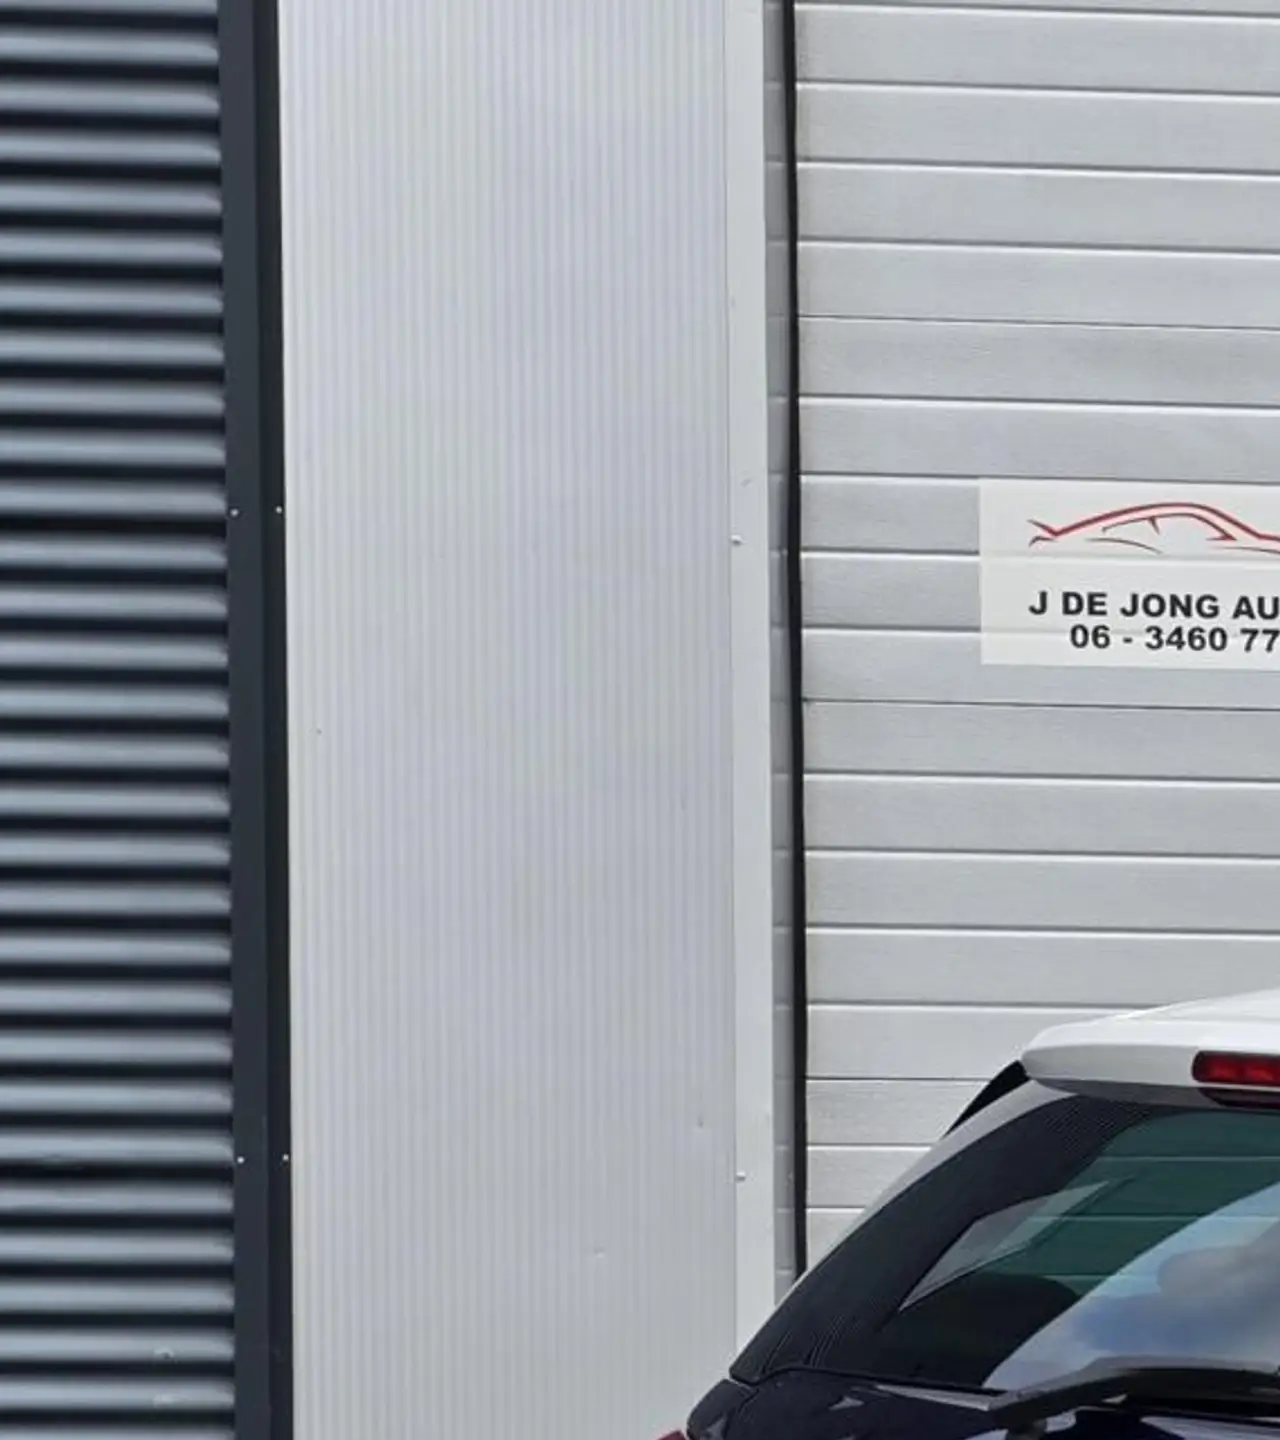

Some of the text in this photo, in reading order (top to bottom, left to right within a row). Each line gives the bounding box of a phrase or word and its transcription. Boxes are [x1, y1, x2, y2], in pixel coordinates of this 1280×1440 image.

[1029, 591, 1047, 615] J
[1062, 591, 1107, 616] DE
[1120, 593, 1219, 619] JONG
[1070, 624, 1110, 649] 06
[1145, 625, 1228, 651] 3460
